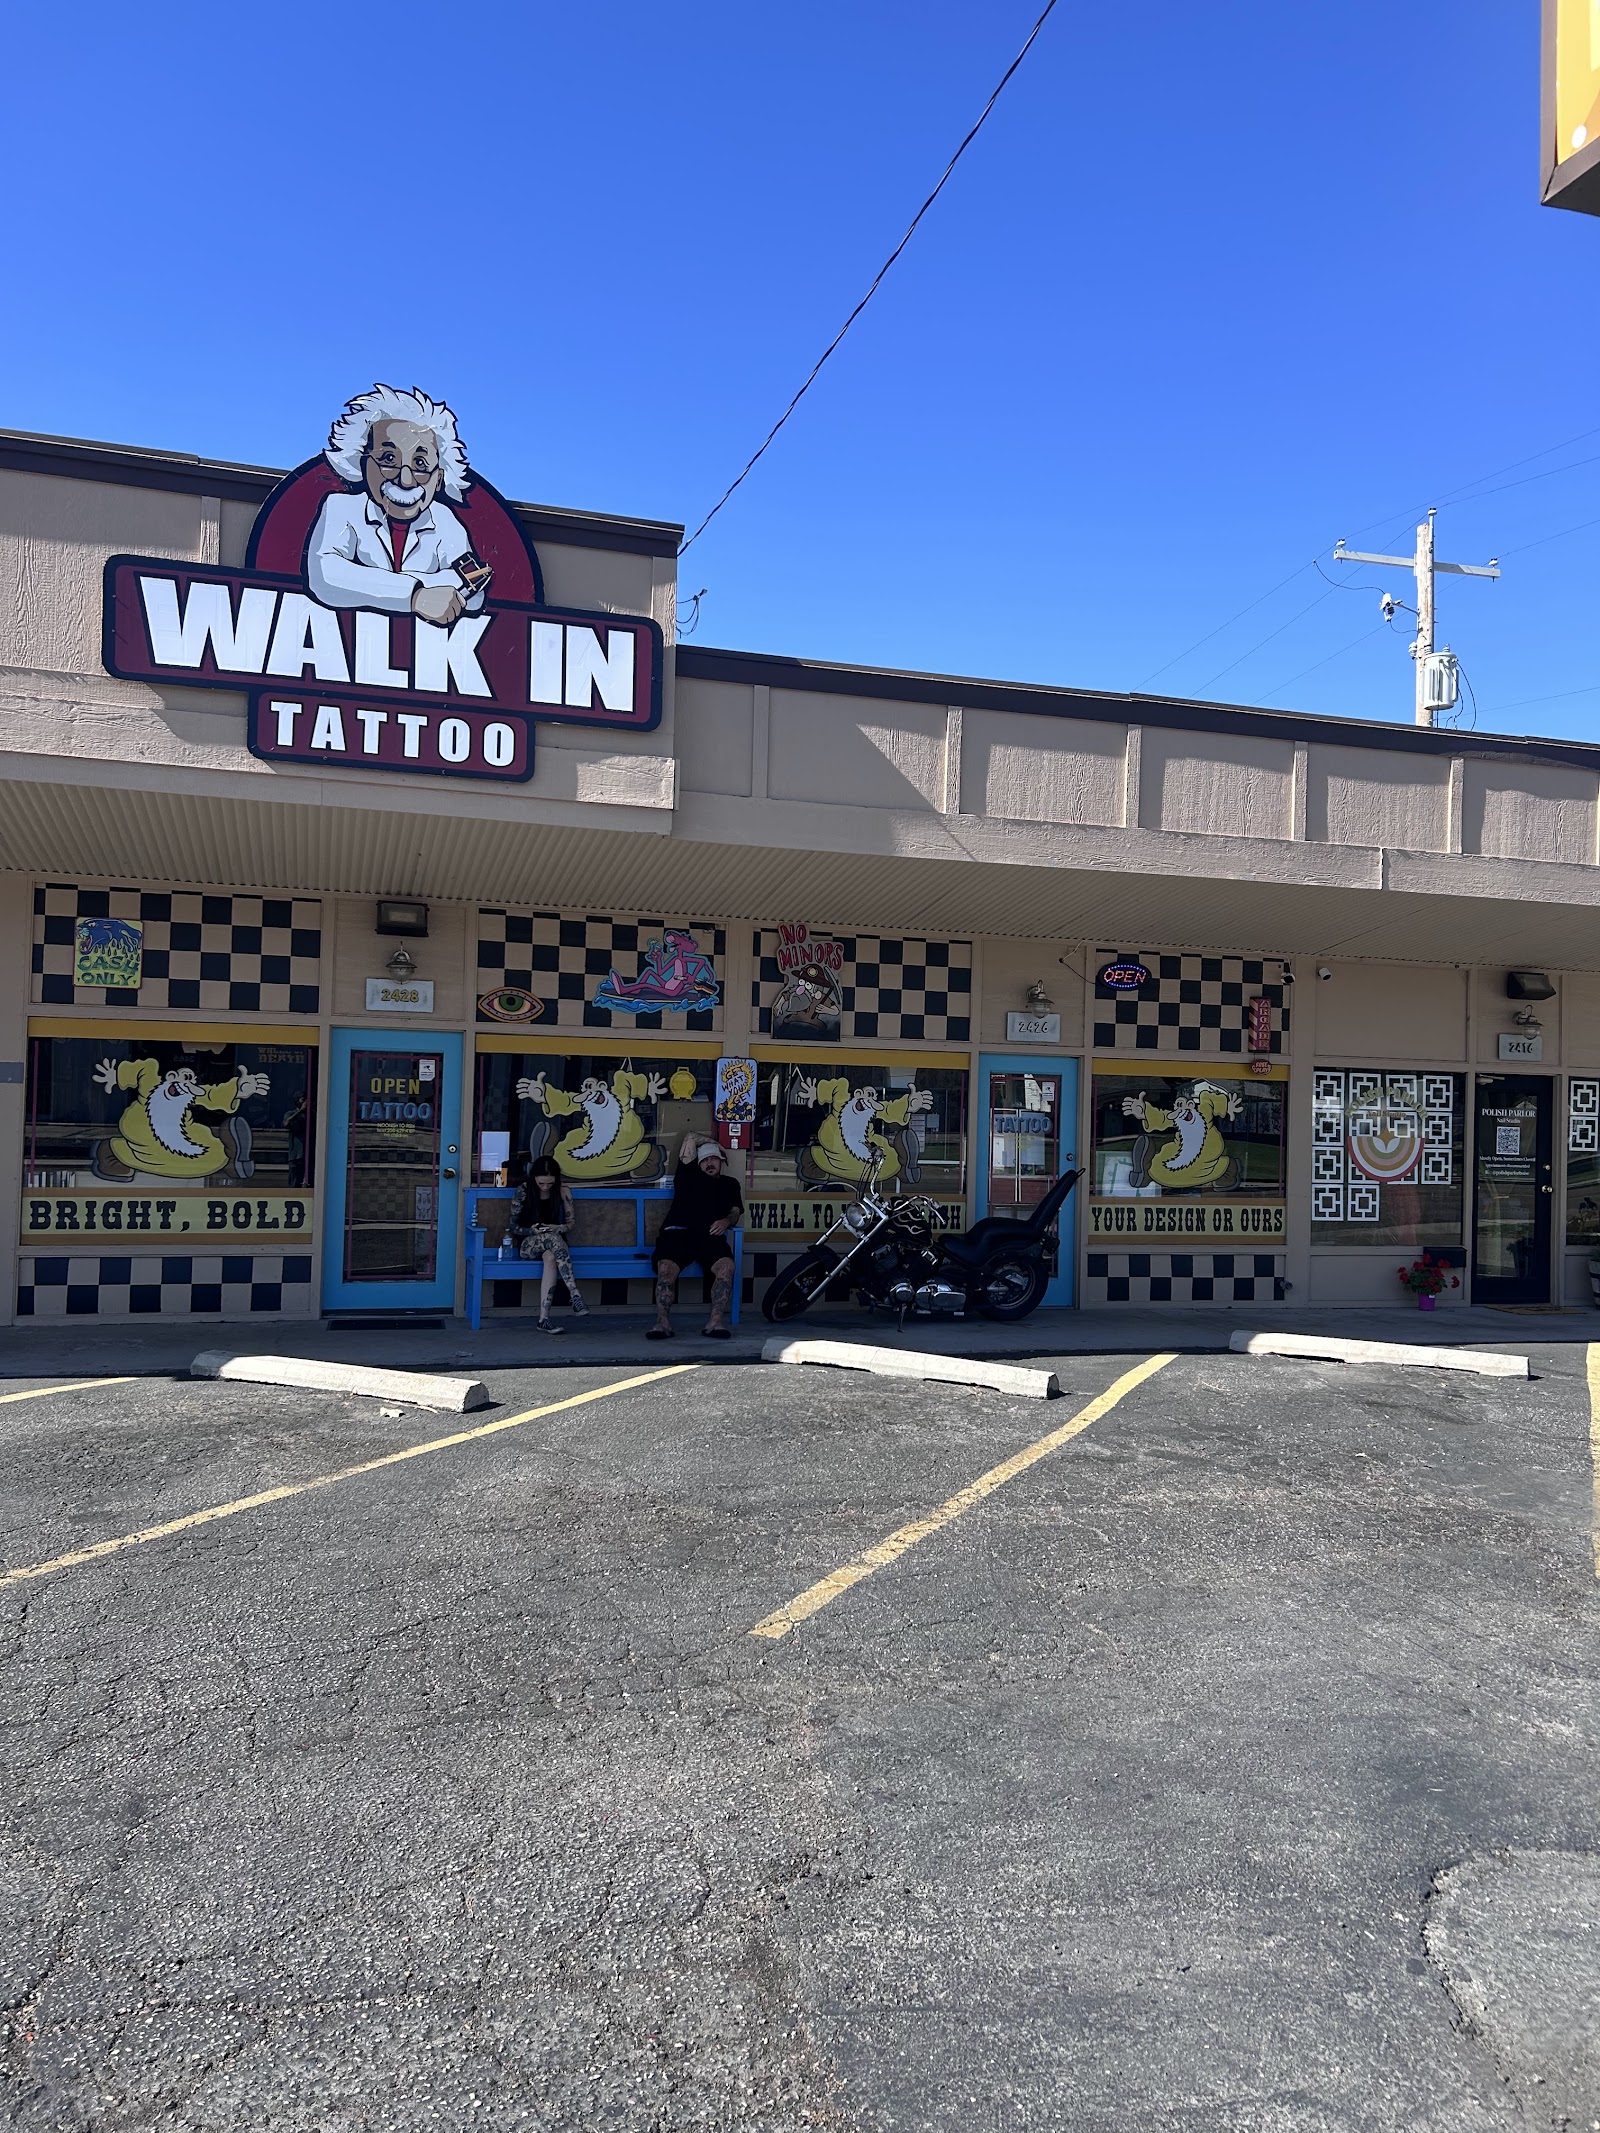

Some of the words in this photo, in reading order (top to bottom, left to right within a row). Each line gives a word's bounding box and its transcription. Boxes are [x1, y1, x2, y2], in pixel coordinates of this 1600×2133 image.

[139, 576, 493, 698] WALK
[530, 621, 635, 713] IN
[270, 701, 516, 767] TATTOO
[780, 924, 807, 945] NO
[78, 955, 139, 975] CASH
[779, 943, 843, 971] MINORS
[81, 972, 133, 986] ONLY
[1103, 969, 1147, 983] OPEN
[380, 988, 420, 1003] 2428
[1018, 1020, 1049, 1034] 2426
[1258, 1000, 1270, 1048] ARCADE
[1508, 1042, 1534, 1054] 2416
[725, 1066, 744, 1081] GET
[370, 1077, 420, 1095] OPEN
[721, 1074, 744, 1092] WHAT
[731, 1089, 752, 1105] GET
[359, 1102, 432, 1121] TATTOO
[1482, 1108, 1508, 1117] POLISH
[1509, 1109, 1536, 1117] PARLOR
[995, 1116, 1053, 1134] TATTOO
[29, 1201, 190, 1233] BRIGHT,
[206, 1201, 307, 1230] BOLD
[749, 1203, 805, 1229] WALL
[813, 1203, 834, 1229] TO
[1091, 1207, 1138, 1232] YOUR
[1144, 1207, 1206, 1232] DESIGN
[1212, 1207, 1234, 1232] OR
[1240, 1207, 1284, 1232] OURS
